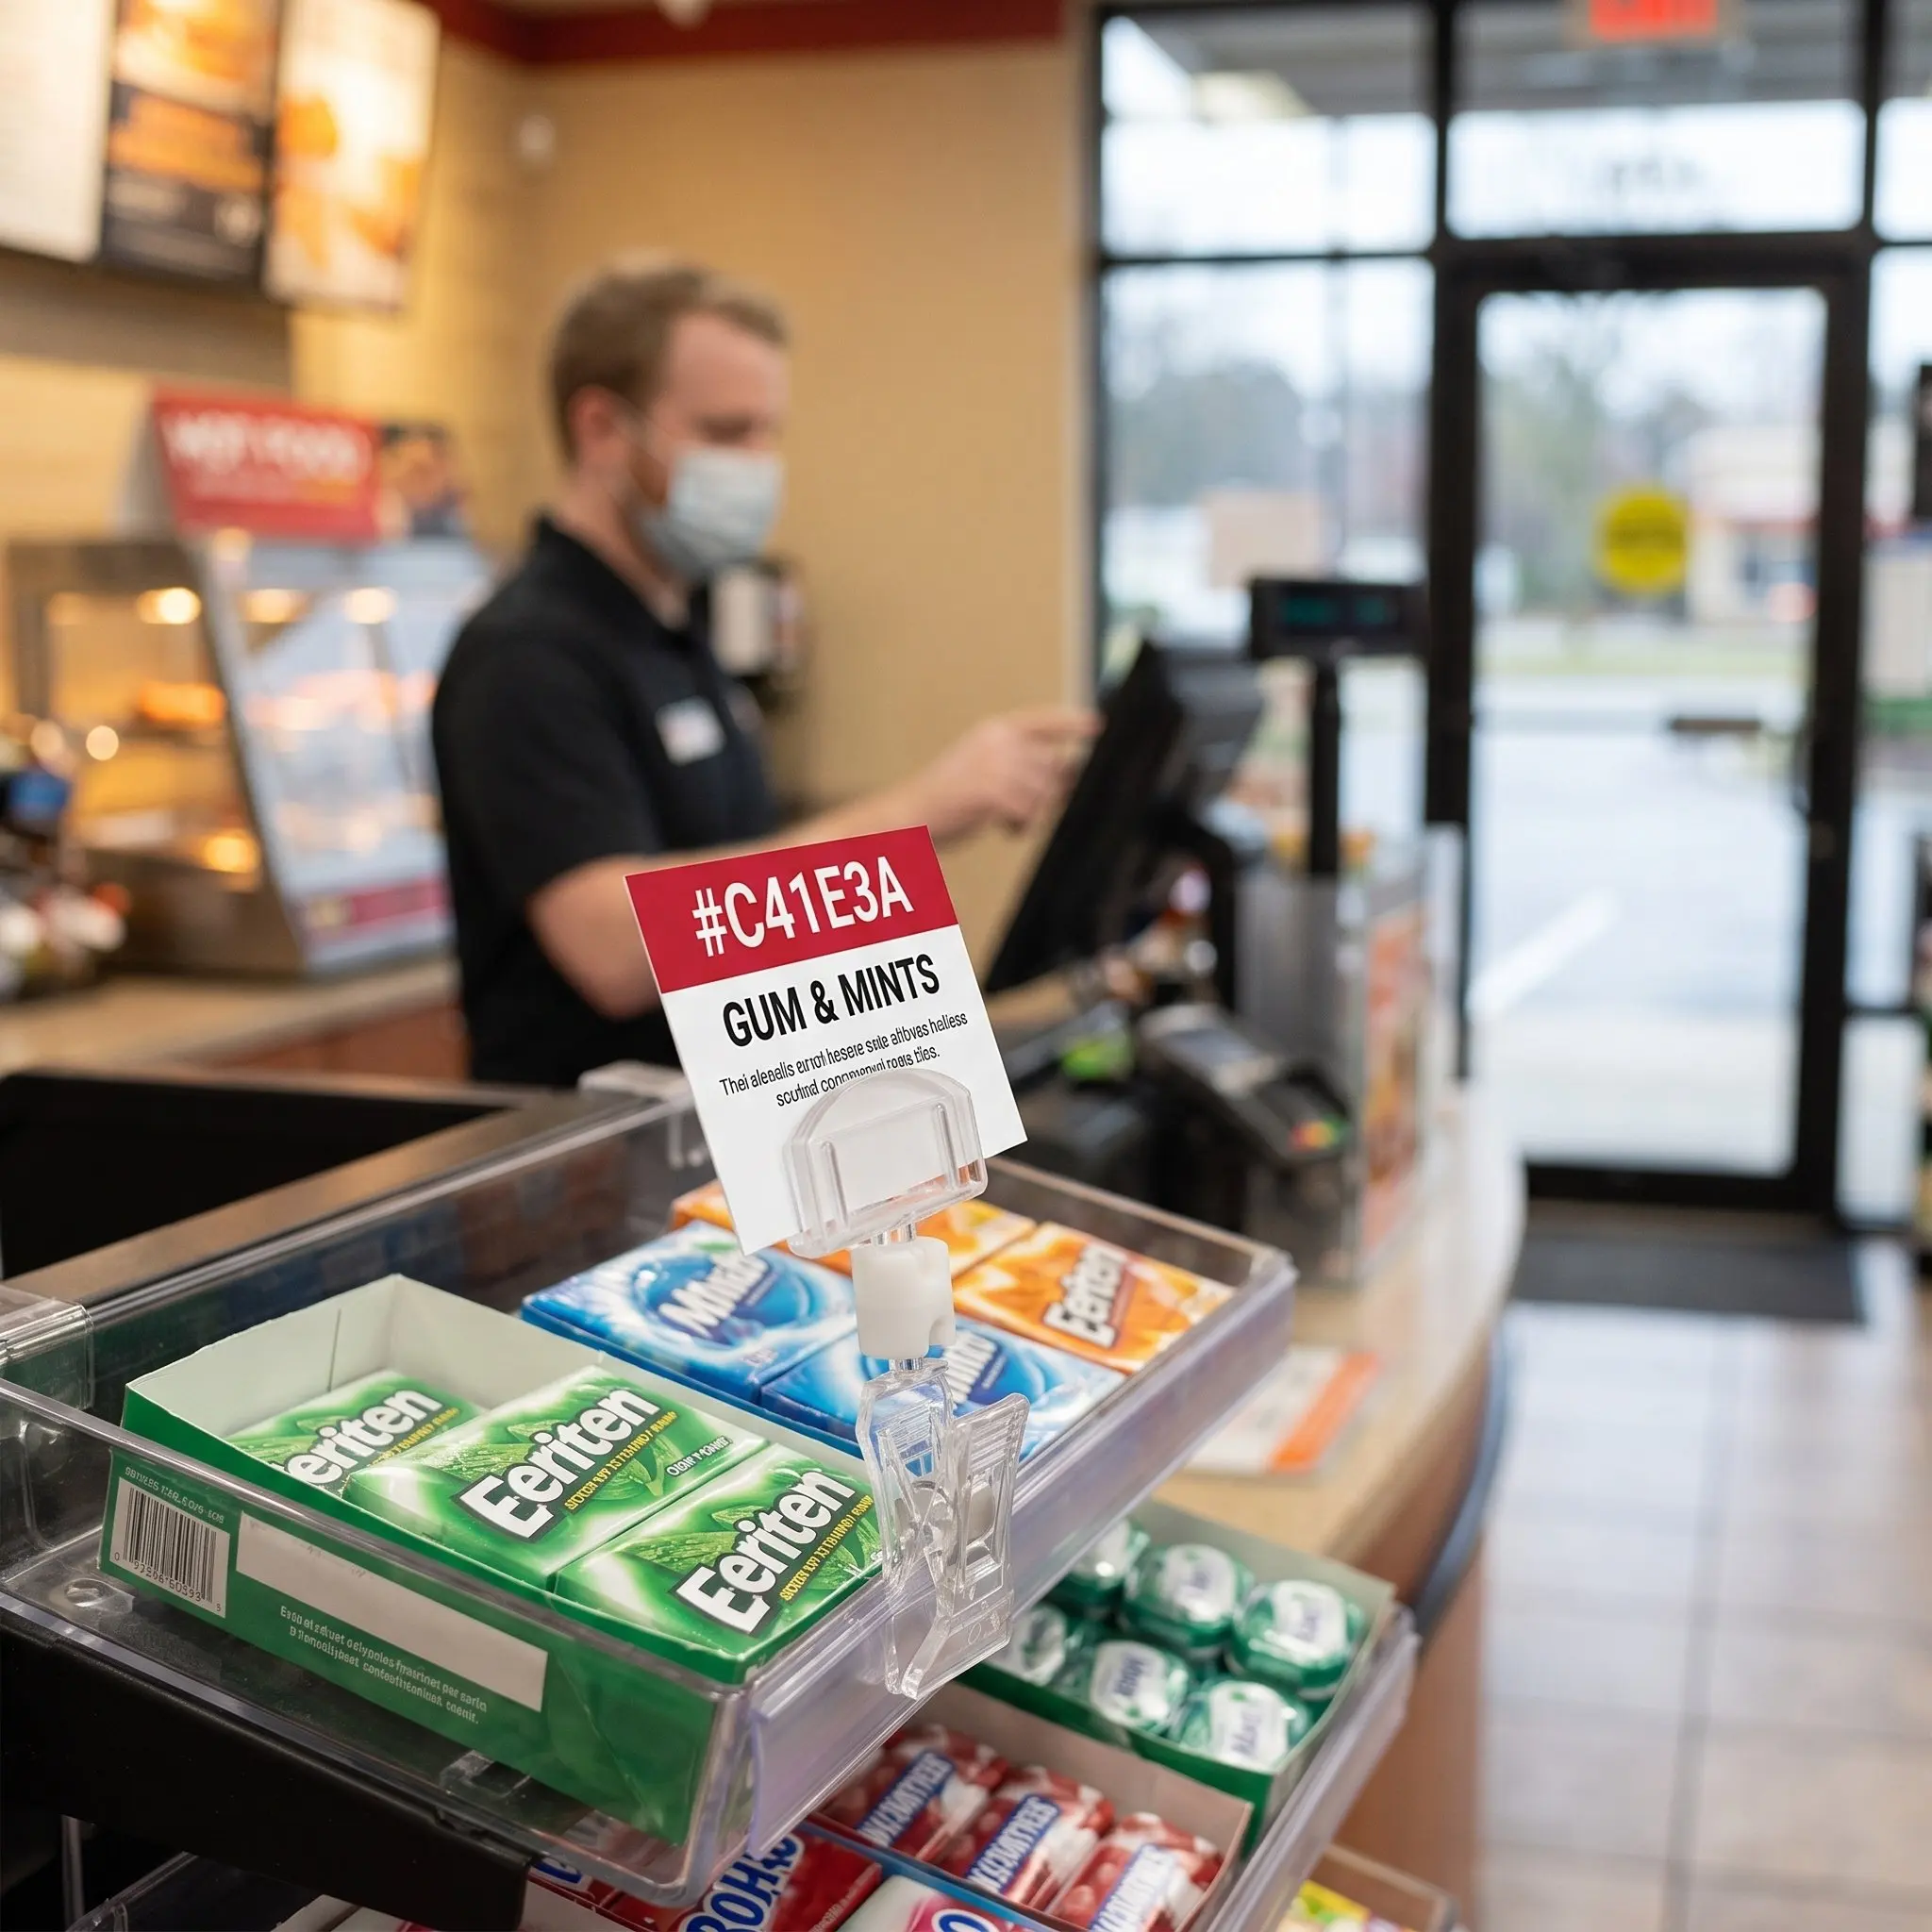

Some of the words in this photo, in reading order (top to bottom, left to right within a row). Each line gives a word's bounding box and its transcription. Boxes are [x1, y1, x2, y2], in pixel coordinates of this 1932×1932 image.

[691, 856, 915, 957] #C41E3A
[723, 987, 808, 1046] GUM
[810, 980, 840, 1024] &
[838, 954, 940, 1017] MINTS
[283, 1391, 442, 1485] eriten
[458, 1388, 659, 1540] Eeriten
[675, 1471, 856, 1634] Eeriten
